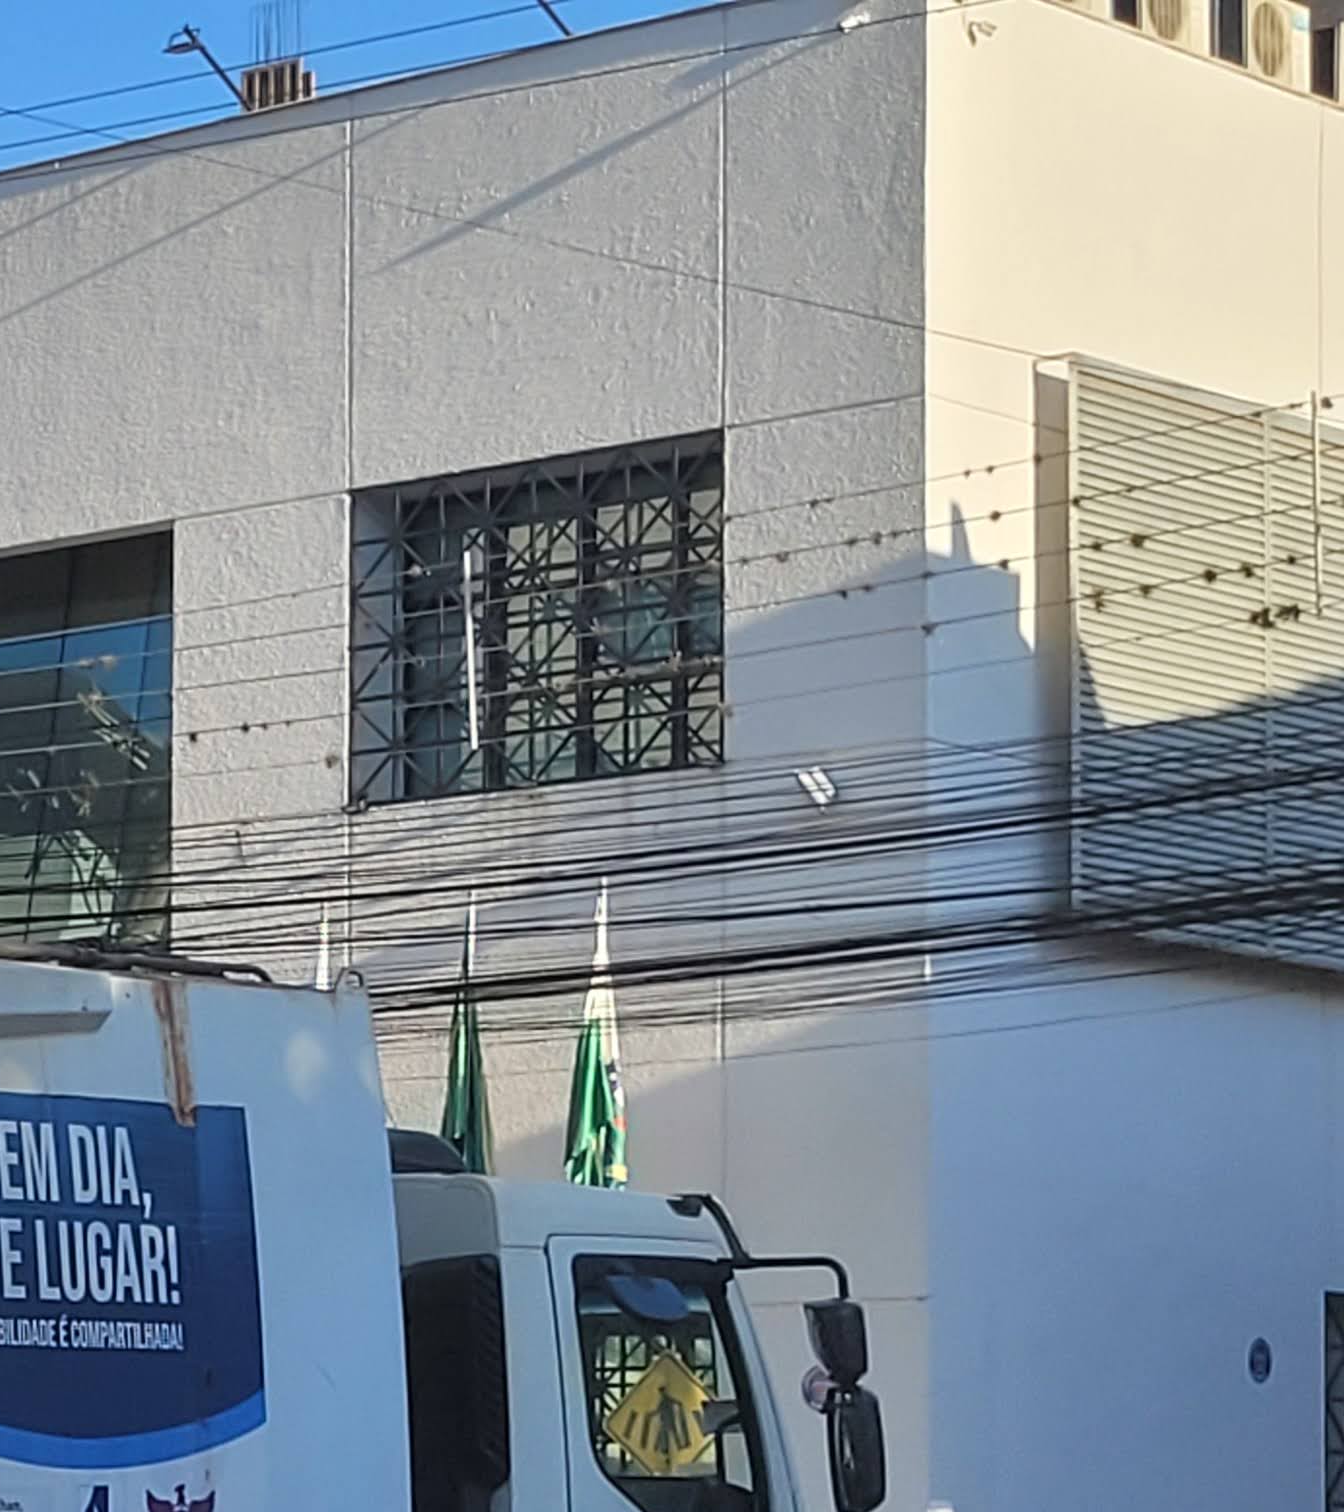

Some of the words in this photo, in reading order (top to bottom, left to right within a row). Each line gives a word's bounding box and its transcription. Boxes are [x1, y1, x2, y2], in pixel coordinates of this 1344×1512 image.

[67, 1123, 153, 1219] DIA,
[34, 1218, 182, 1305] LUGAR!
[60, 1313, 69, 1347] É
[70, 1319, 184, 1350] COMPARTILHADA!
